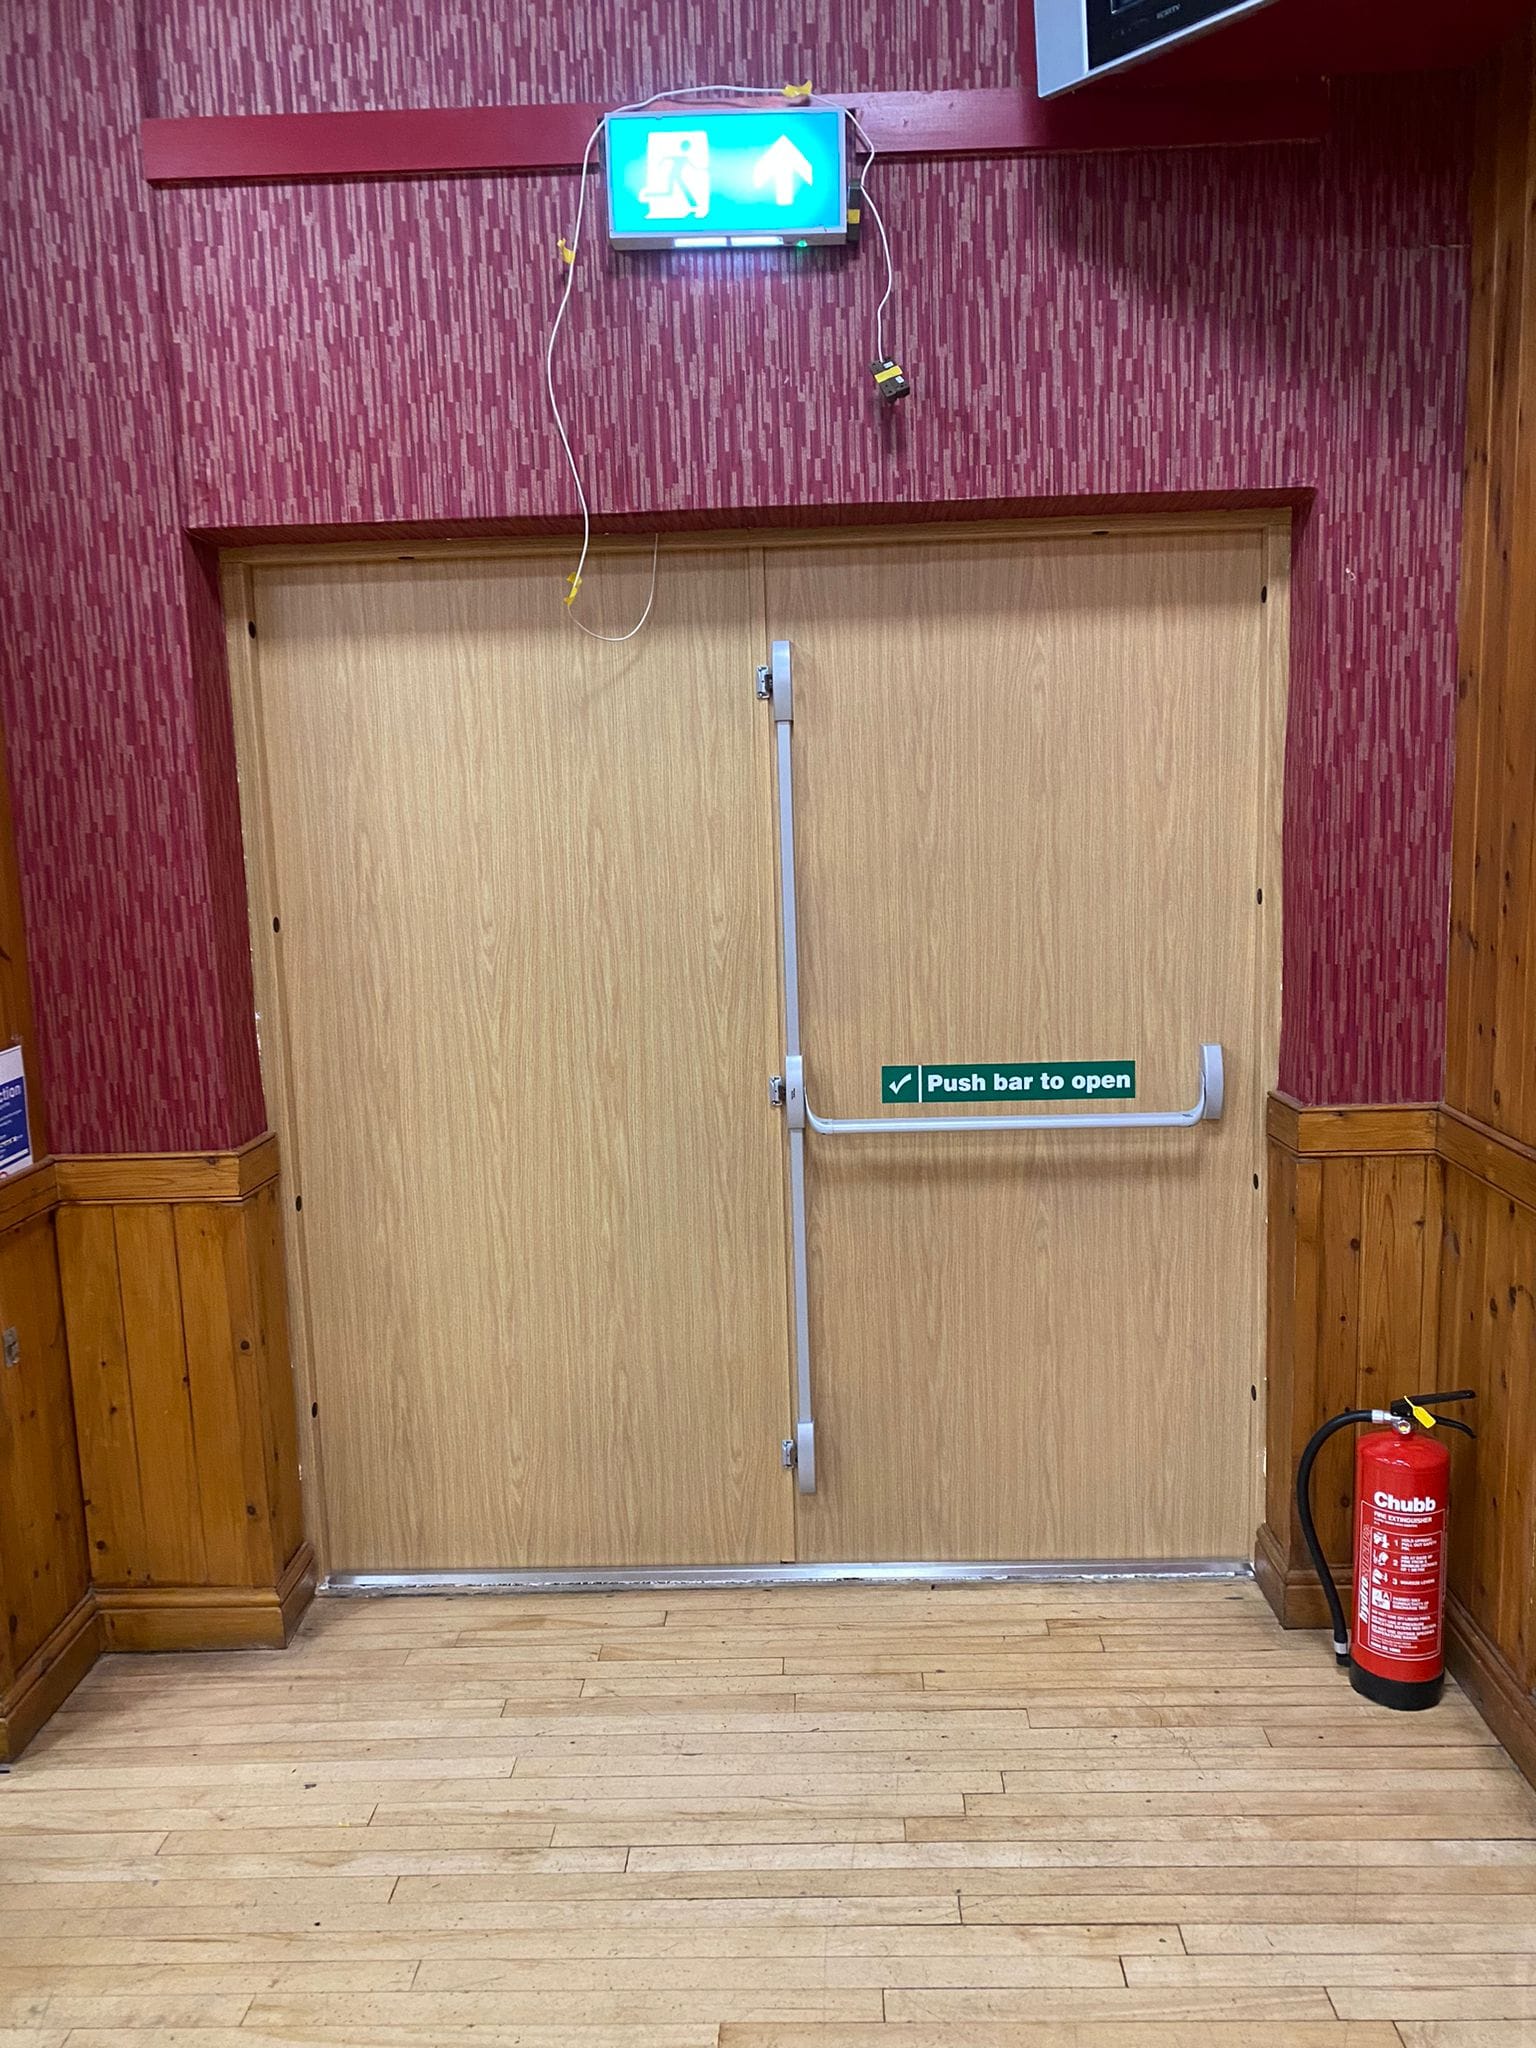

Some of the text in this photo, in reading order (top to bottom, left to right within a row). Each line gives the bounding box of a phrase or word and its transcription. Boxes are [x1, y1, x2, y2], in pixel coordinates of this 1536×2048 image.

[927, 1073, 1132, 1093] Push bar to open
[1373, 1491, 1436, 1512] Chubb
